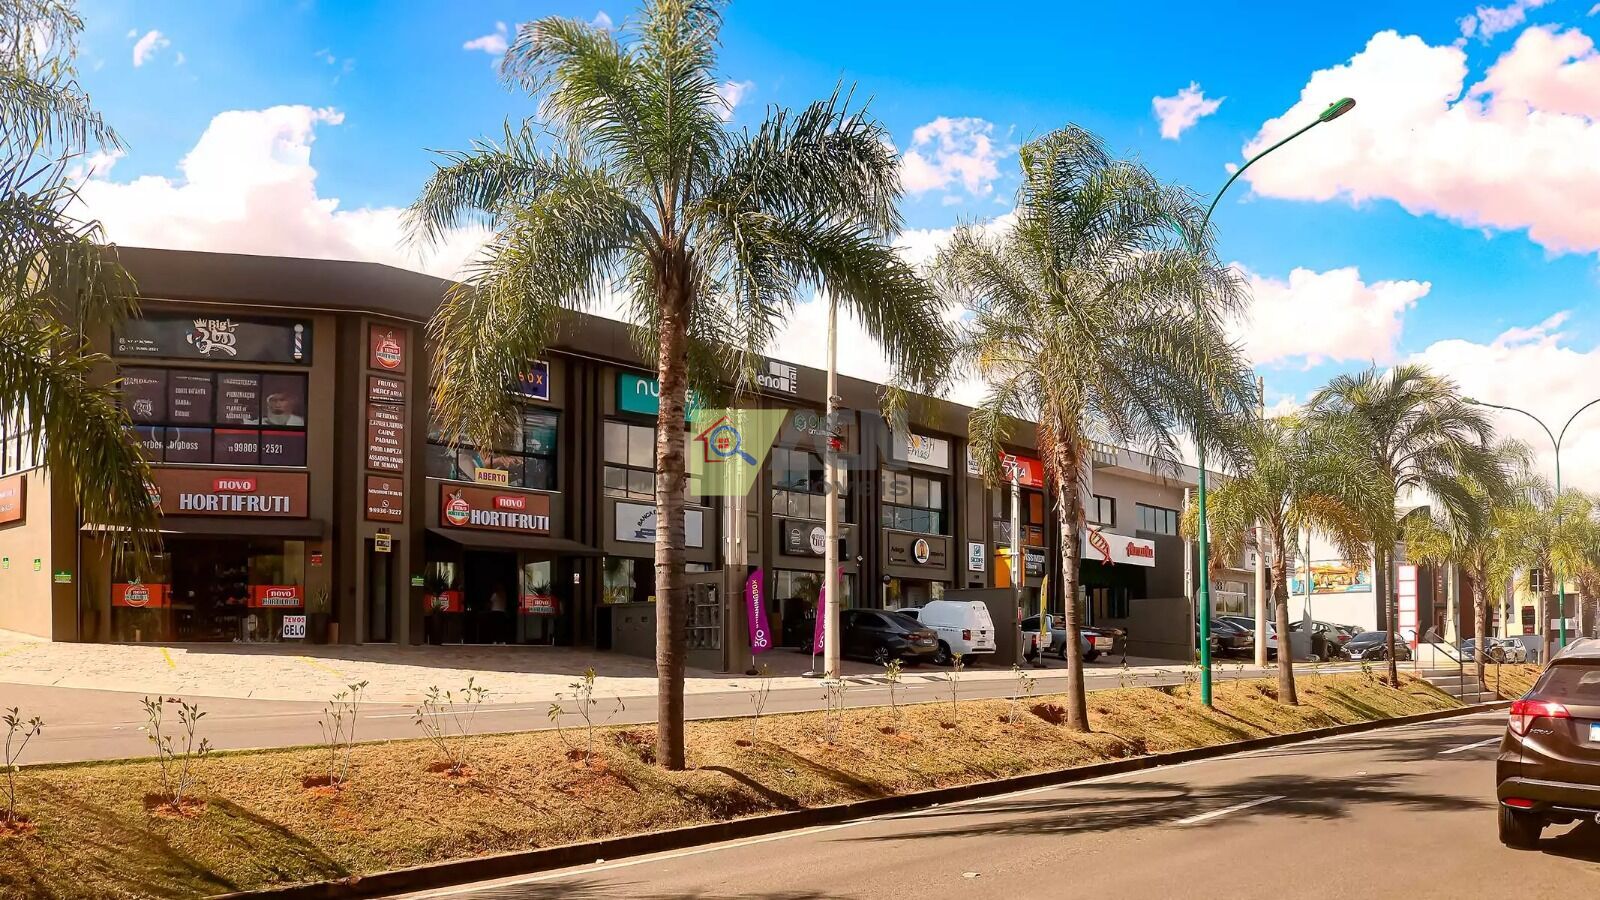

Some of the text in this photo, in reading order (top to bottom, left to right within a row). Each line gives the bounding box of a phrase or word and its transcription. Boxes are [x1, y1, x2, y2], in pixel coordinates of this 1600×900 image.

[477, 471, 506, 483] ABERTO
[218, 479, 251, 490] novo
[179, 493, 290, 513] HORTIFRUTI
[499, 498, 522, 507] novo
[470, 509, 550, 530] HORTIFRUTI
[637, 511, 654, 527] BANCA
[284, 624, 305, 636] GELO
